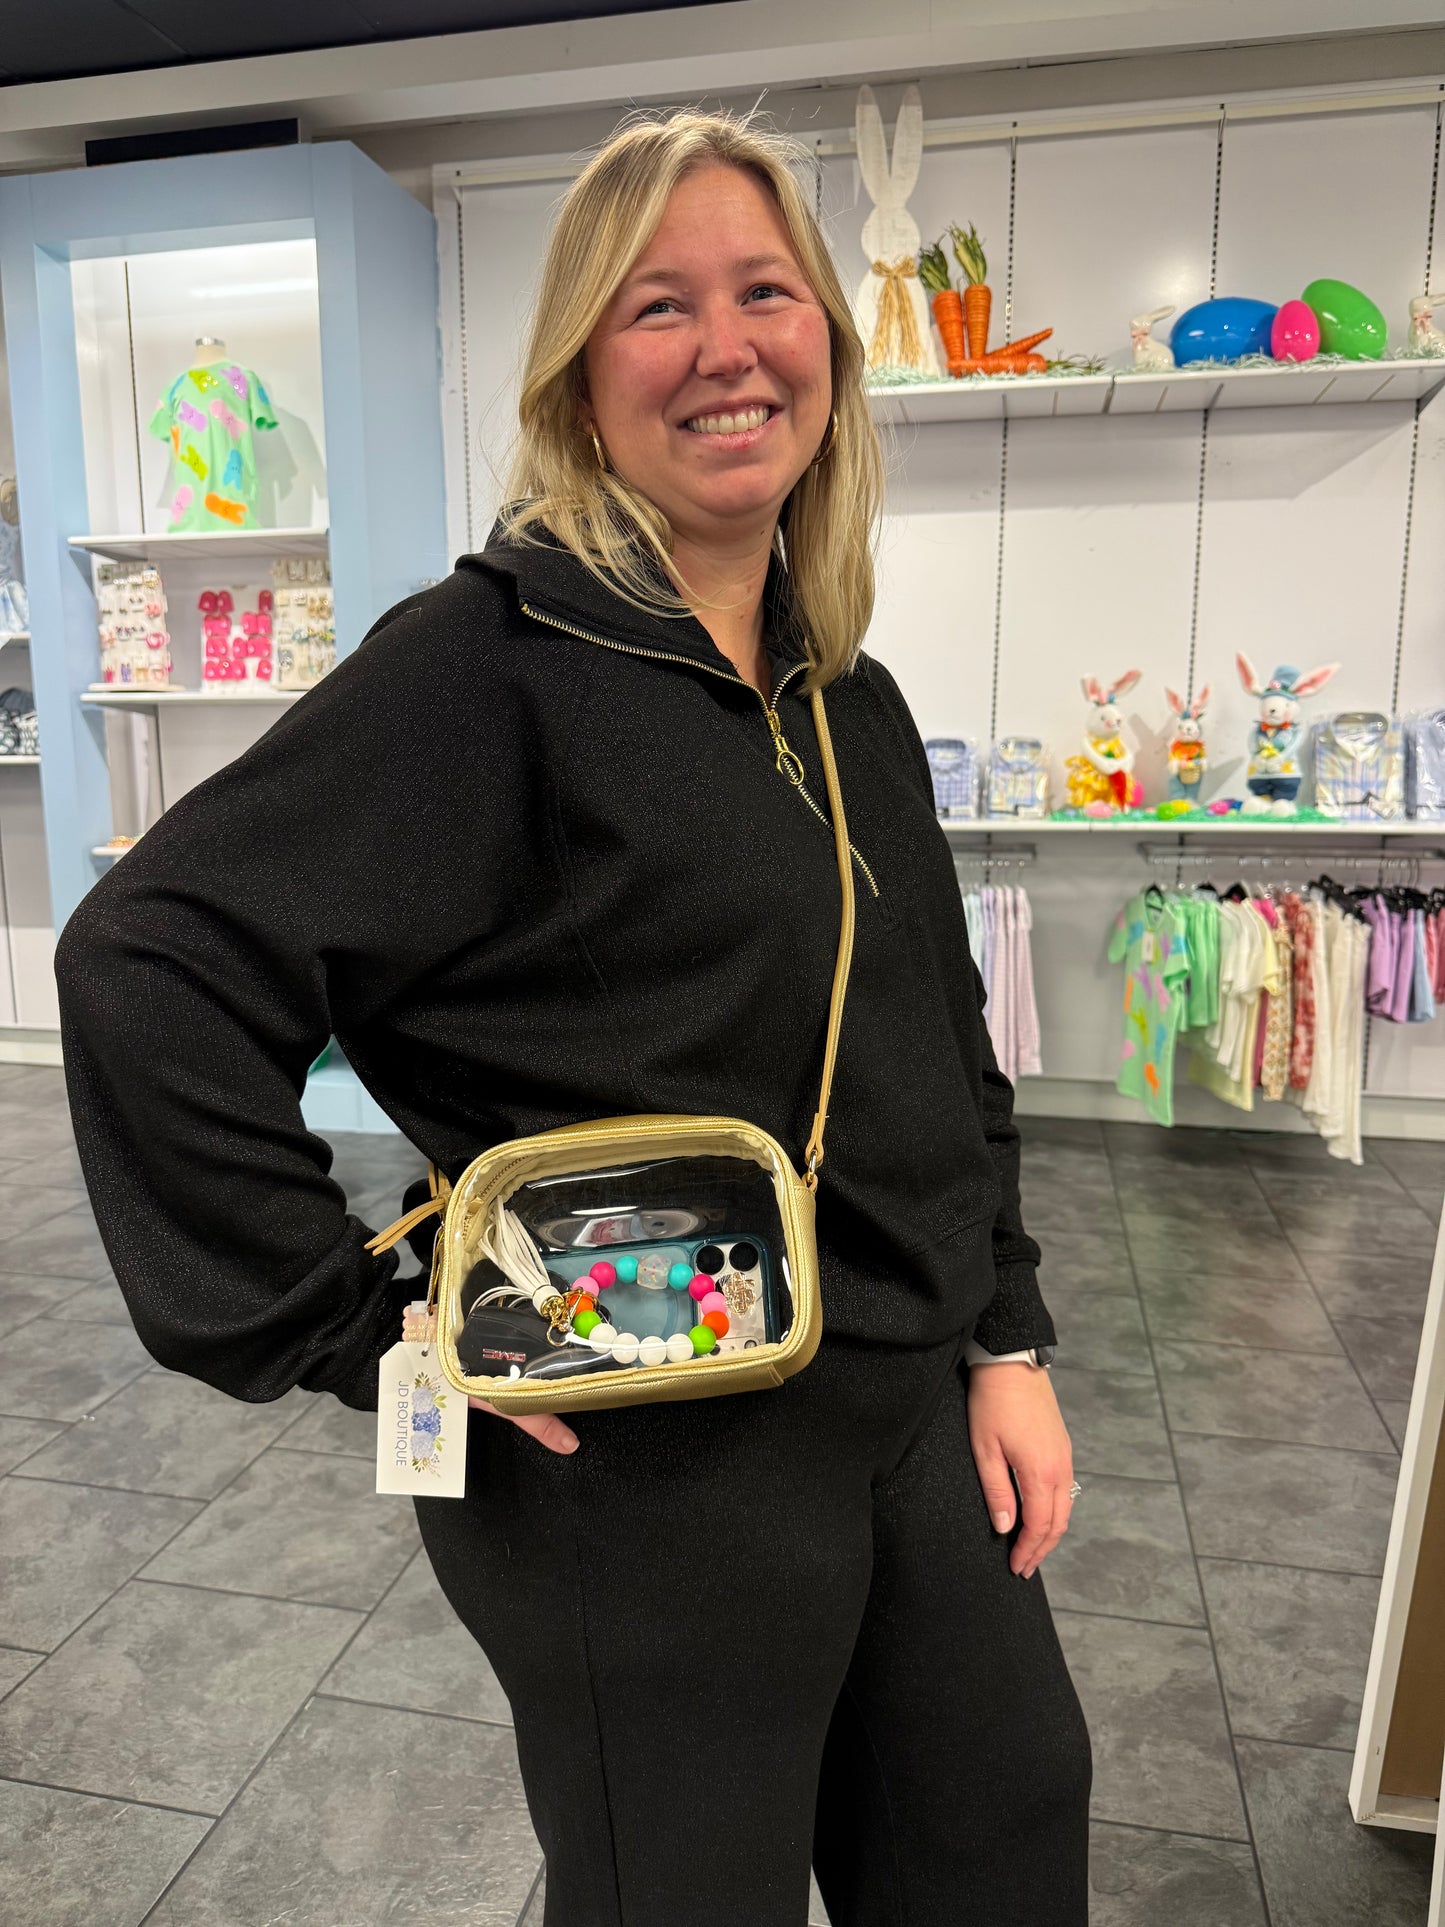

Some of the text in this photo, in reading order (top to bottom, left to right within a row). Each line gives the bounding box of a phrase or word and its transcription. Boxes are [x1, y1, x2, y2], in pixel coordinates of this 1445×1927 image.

[482, 1348, 527, 1363] GMC
[394, 1380, 409, 1466] JD BOUTIQUE
